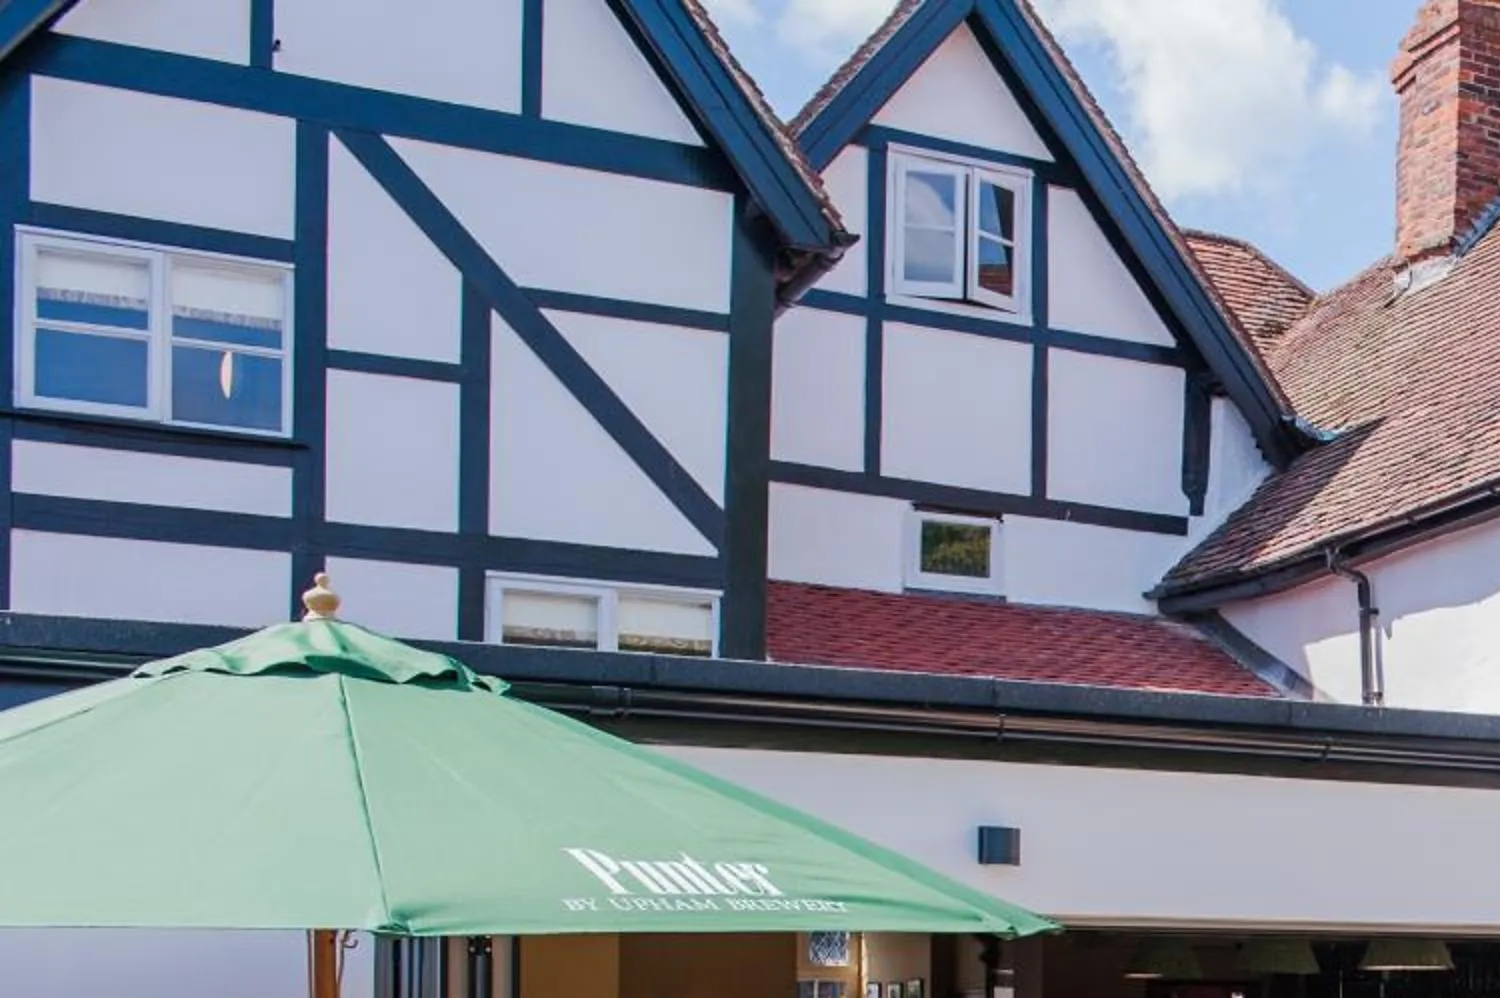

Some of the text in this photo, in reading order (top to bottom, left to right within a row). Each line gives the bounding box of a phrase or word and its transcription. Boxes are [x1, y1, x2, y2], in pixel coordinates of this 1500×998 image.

[562, 848, 783, 896] Punter
[564, 898, 848, 912] BY UPHAM BREWERY
